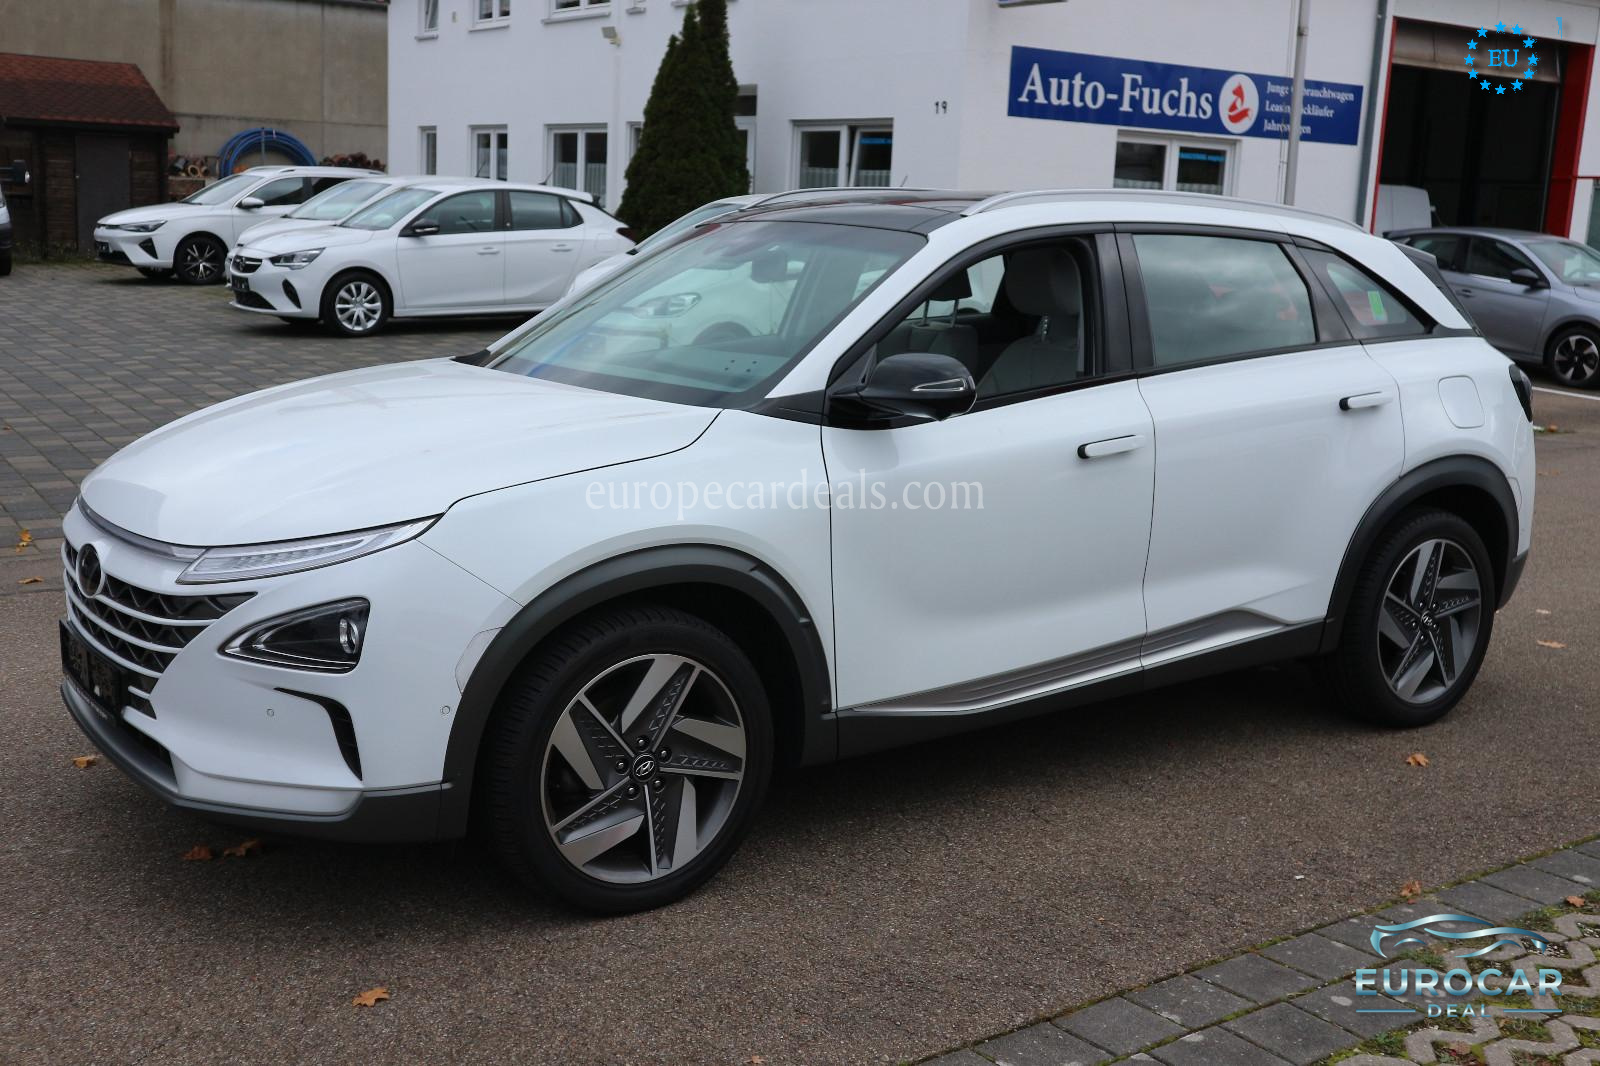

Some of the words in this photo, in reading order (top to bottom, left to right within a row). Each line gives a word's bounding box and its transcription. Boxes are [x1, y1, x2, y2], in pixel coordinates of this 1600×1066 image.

[1018, 62, 1213, 119] Auto-Fuchs
[1291, 87, 1354, 103] rauchtwagen
[934, 101, 948, 114] 19
[1265, 100, 1334, 118] Leasinckläufer
[1263, 119, 1312, 134] Jahreswen
